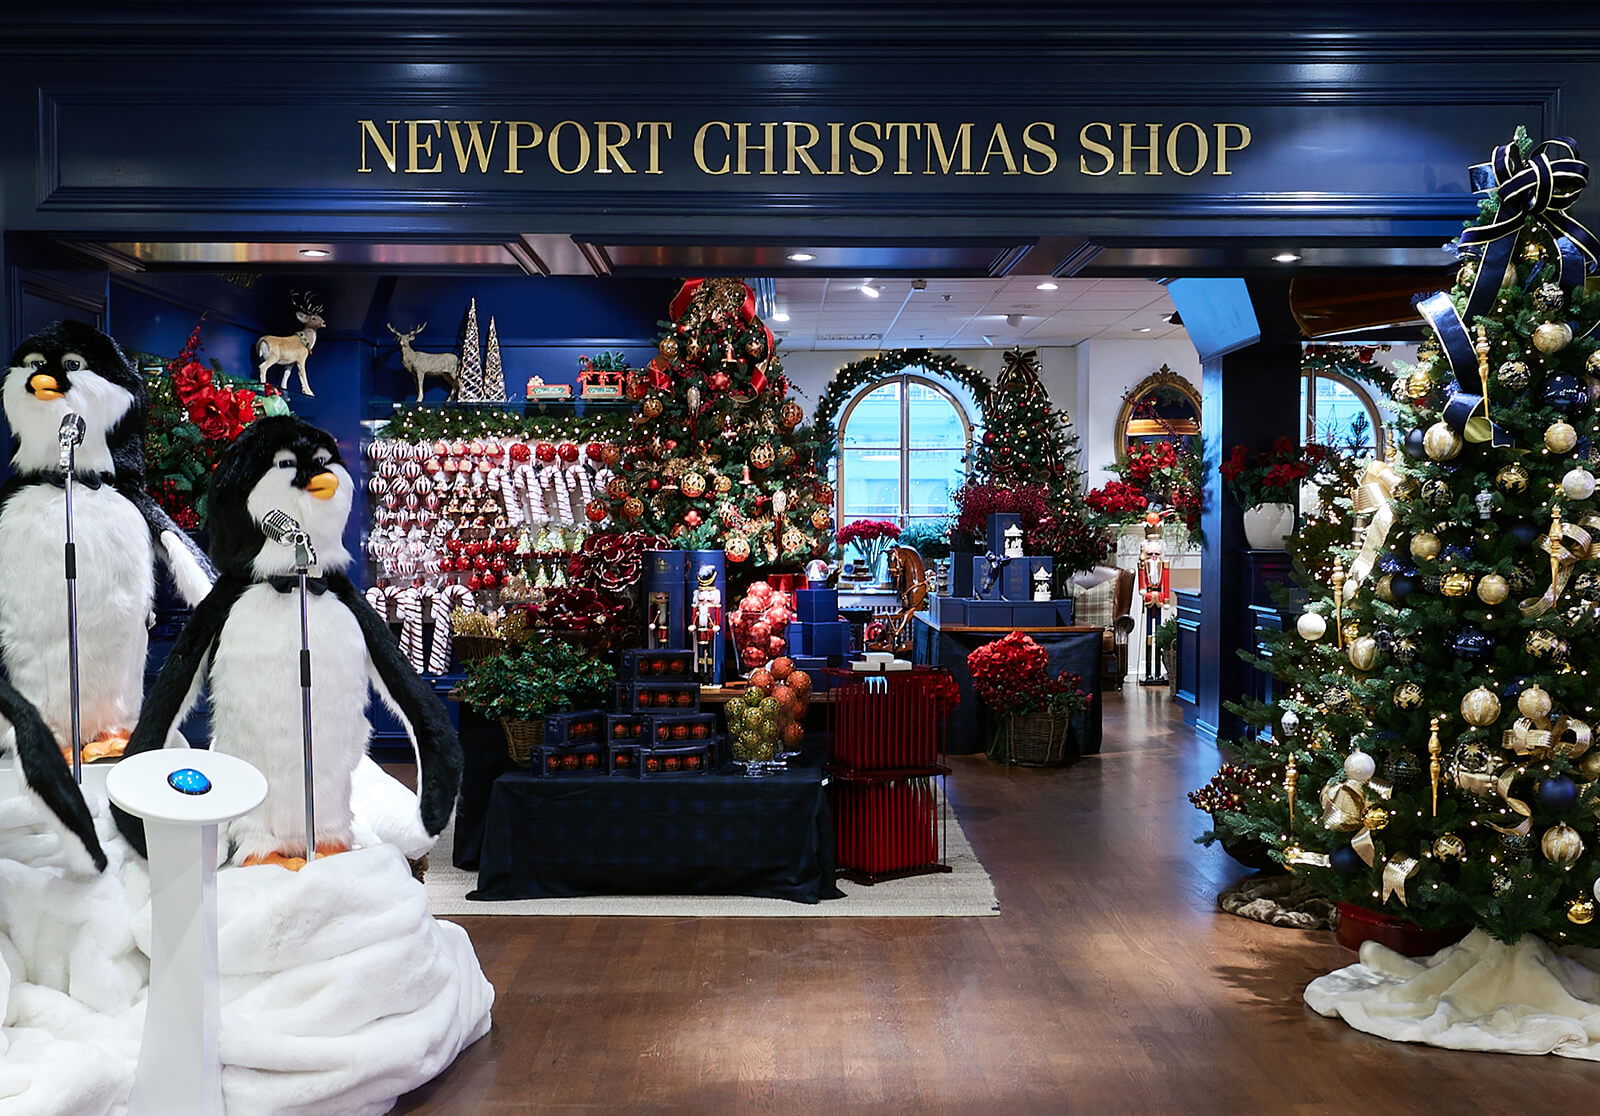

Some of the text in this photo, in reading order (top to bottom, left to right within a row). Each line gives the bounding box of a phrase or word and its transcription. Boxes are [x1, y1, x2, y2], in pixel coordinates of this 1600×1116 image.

[357, 120, 1252, 176] NEWPORT CHRISTMAS SHOP
